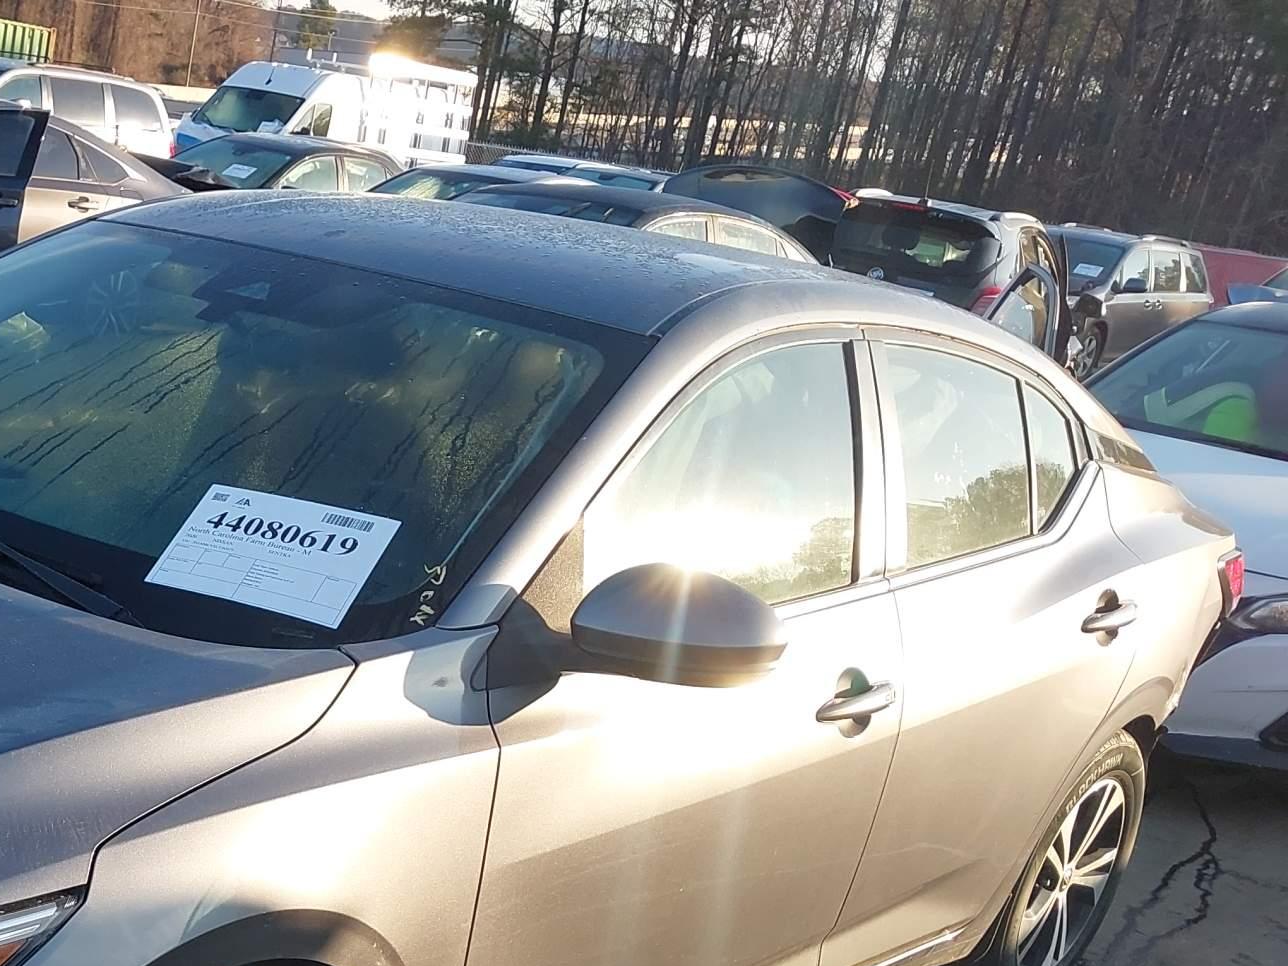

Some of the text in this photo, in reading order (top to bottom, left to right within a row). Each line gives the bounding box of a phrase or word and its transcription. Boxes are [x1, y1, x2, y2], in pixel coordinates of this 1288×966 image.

[188, 526, 210, 535] North
[212, 530, 244, 541] Carolina
[245, 536, 266, 546] Farm
[267, 540, 295, 552] Bureau
[206, 511, 359, 556] 44080619
